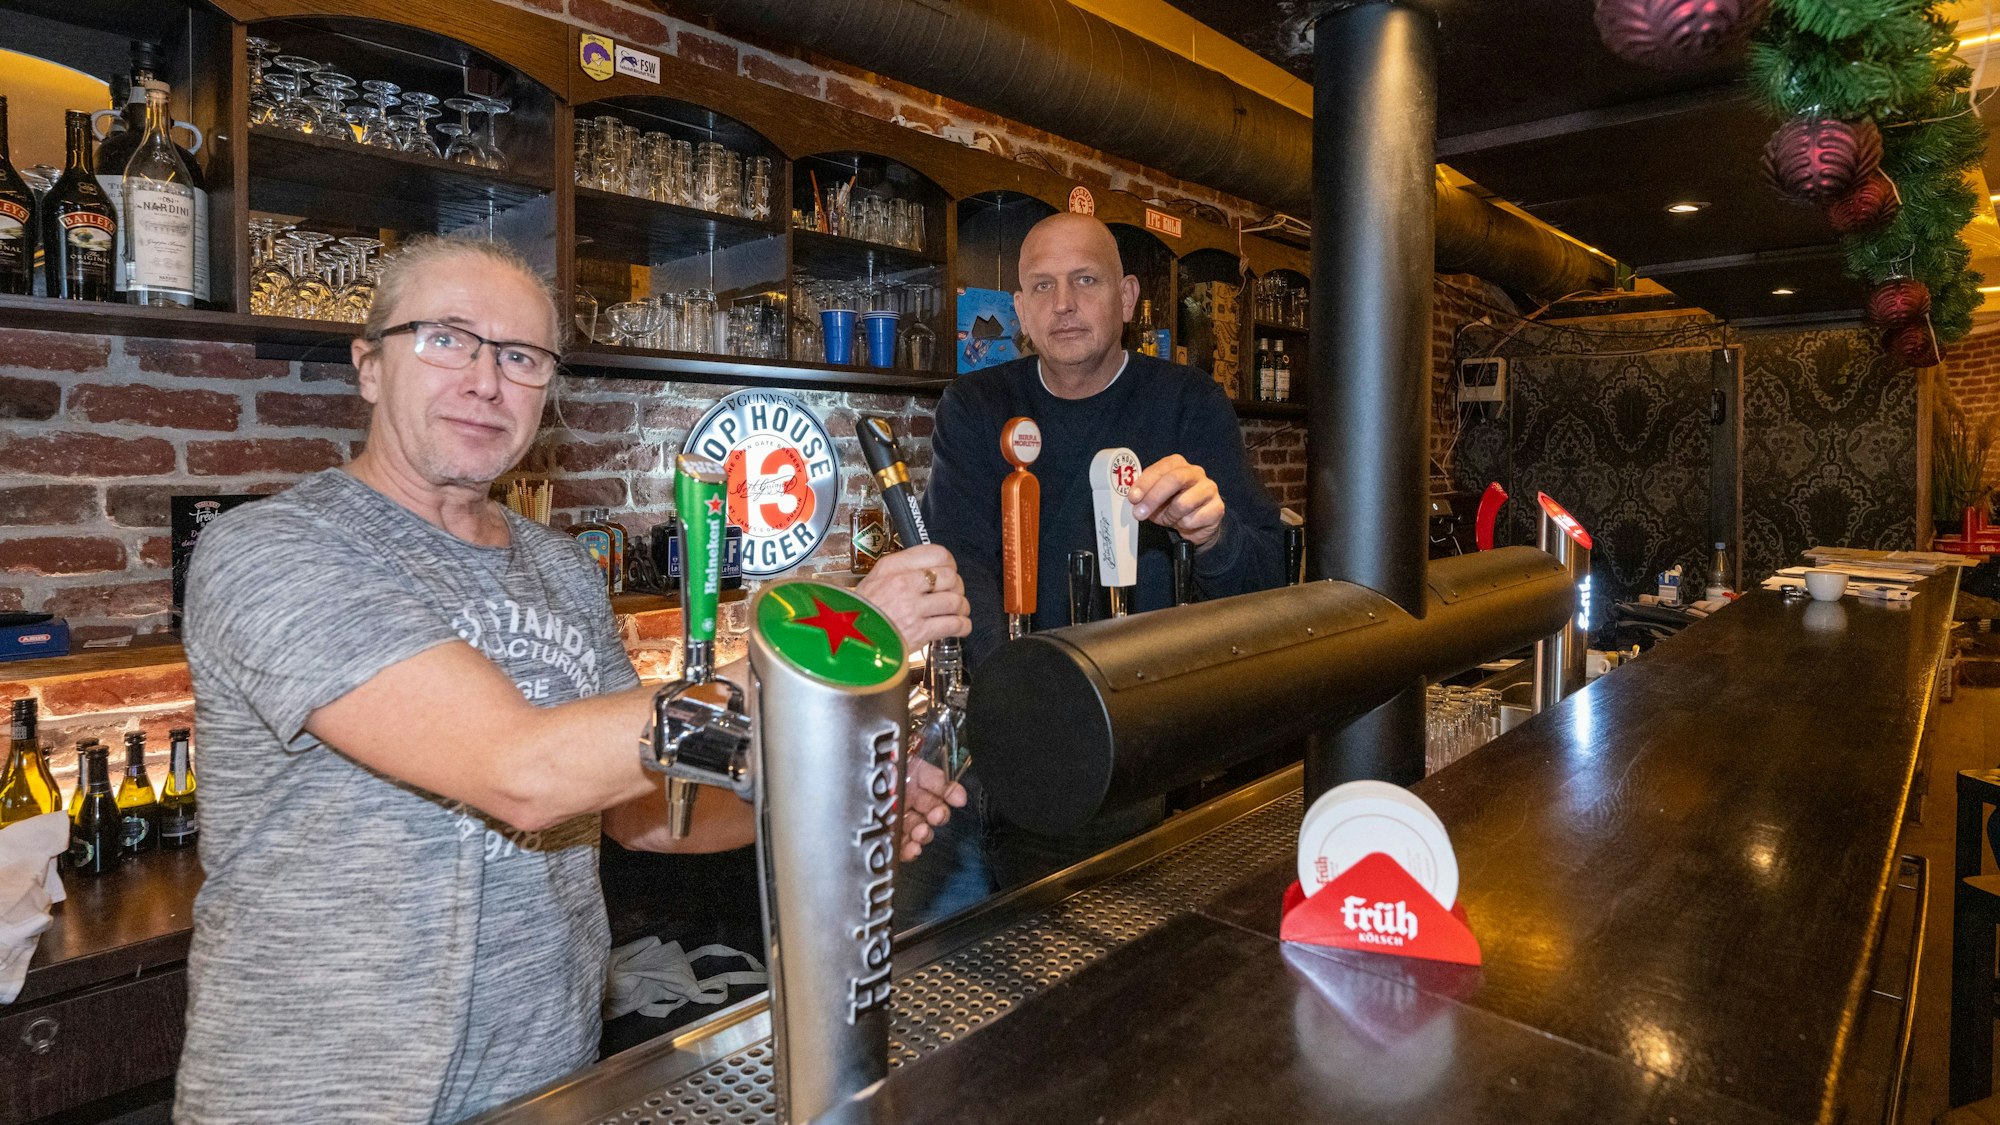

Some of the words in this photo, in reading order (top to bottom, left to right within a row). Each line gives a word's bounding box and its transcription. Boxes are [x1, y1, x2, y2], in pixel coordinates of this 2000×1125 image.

[641, 59, 656, 74] FSW
[64, 214, 115, 231] BAILEYS
[143, 201, 190, 217] NARDINI
[70, 253, 111, 265] ORIGINAL
[737, 393, 795, 410] GUINNESS
[703, 416, 737, 462] OP
[751, 404, 832, 479] HOUSE
[755, 440, 775, 448] GATE
[777, 443, 803, 474] BREWERY
[727, 447, 816, 534] 13
[1116, 465, 1135, 487] 13
[906, 494, 931, 546] UINNESS
[704, 518, 720, 595] Heineken
[742, 522, 816, 567] AGER
[847, 719, 900, 1027] Heineken
[1340, 895, 1418, 941] früh
[1358, 931, 1404, 947] KÖLSCH
